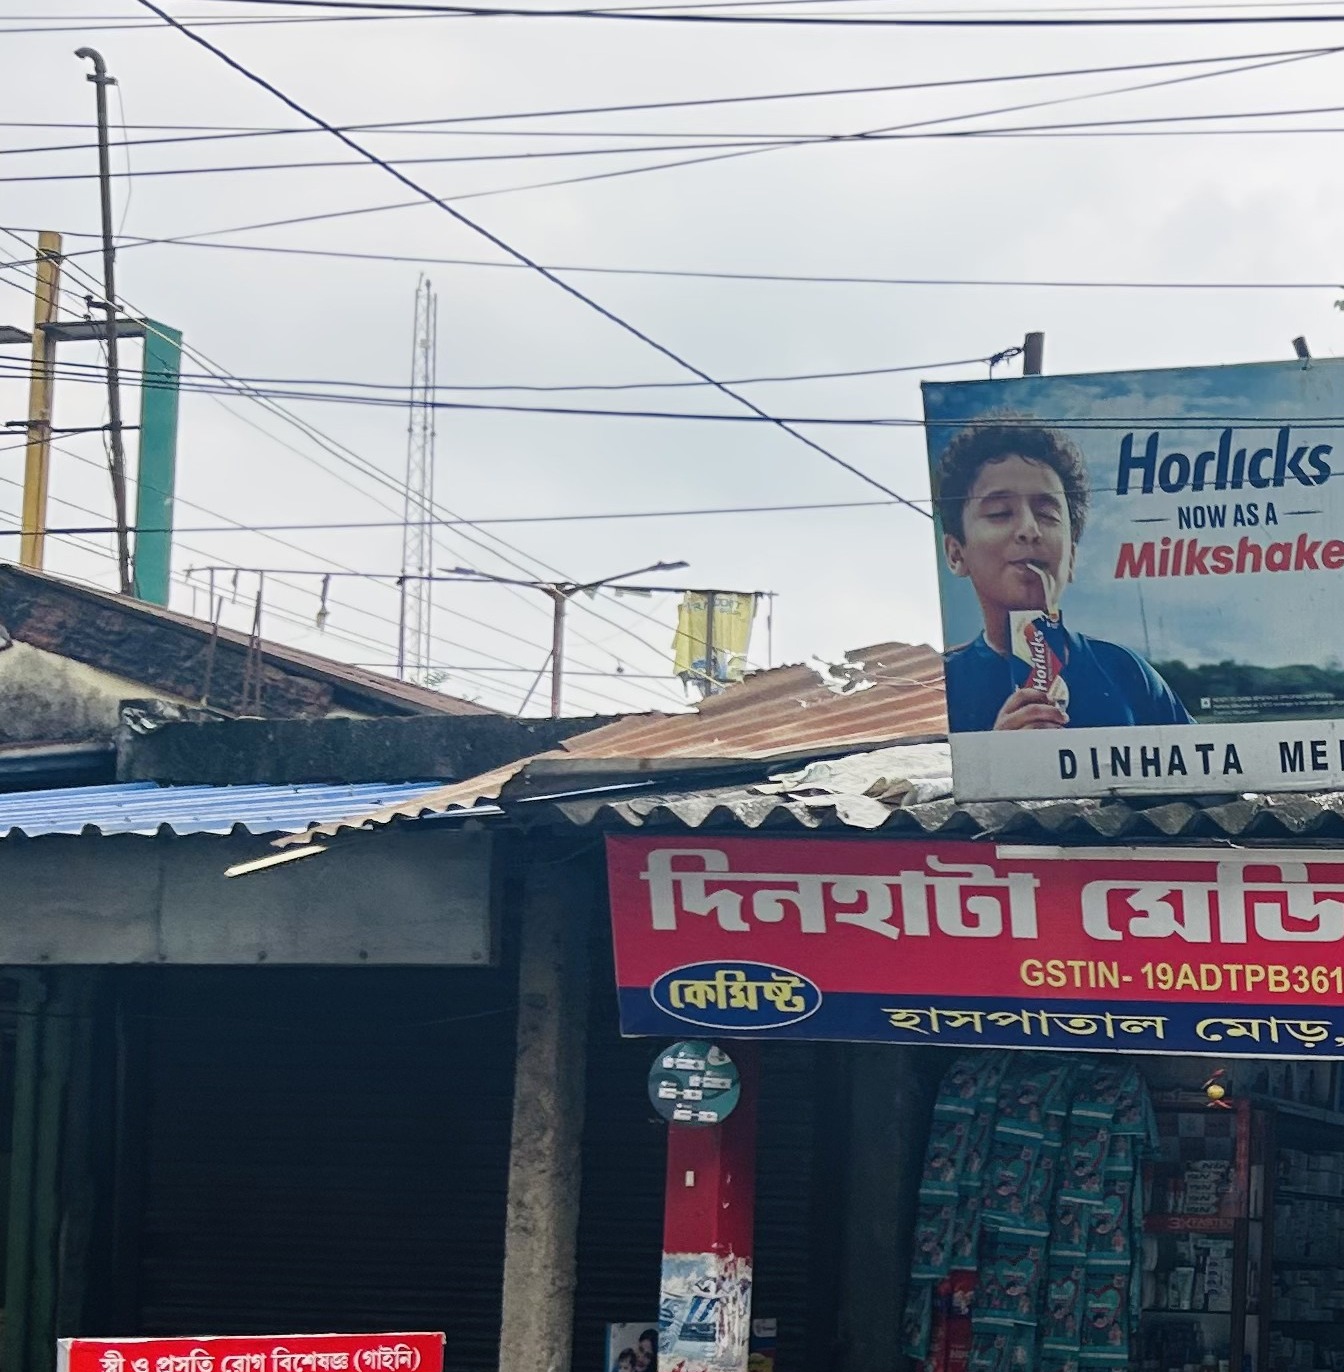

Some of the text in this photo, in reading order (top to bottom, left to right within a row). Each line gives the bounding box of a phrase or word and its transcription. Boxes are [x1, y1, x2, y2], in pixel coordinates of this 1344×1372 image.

[1115, 426, 1332, 496] Horlicks
[1177, 503, 1278, 530] NOW AS A
[1032, 630, 1048, 691] Horlicks
[1059, 743, 1243, 780] DINHATA
[640, 848, 1040, 939] দিনহাটা
[1020, 959, 1132, 988] GSTIN-
[881, 1006, 1167, 1039] হাসপাতাল
[353, 1343, 421, 1372] (গাইনি)
